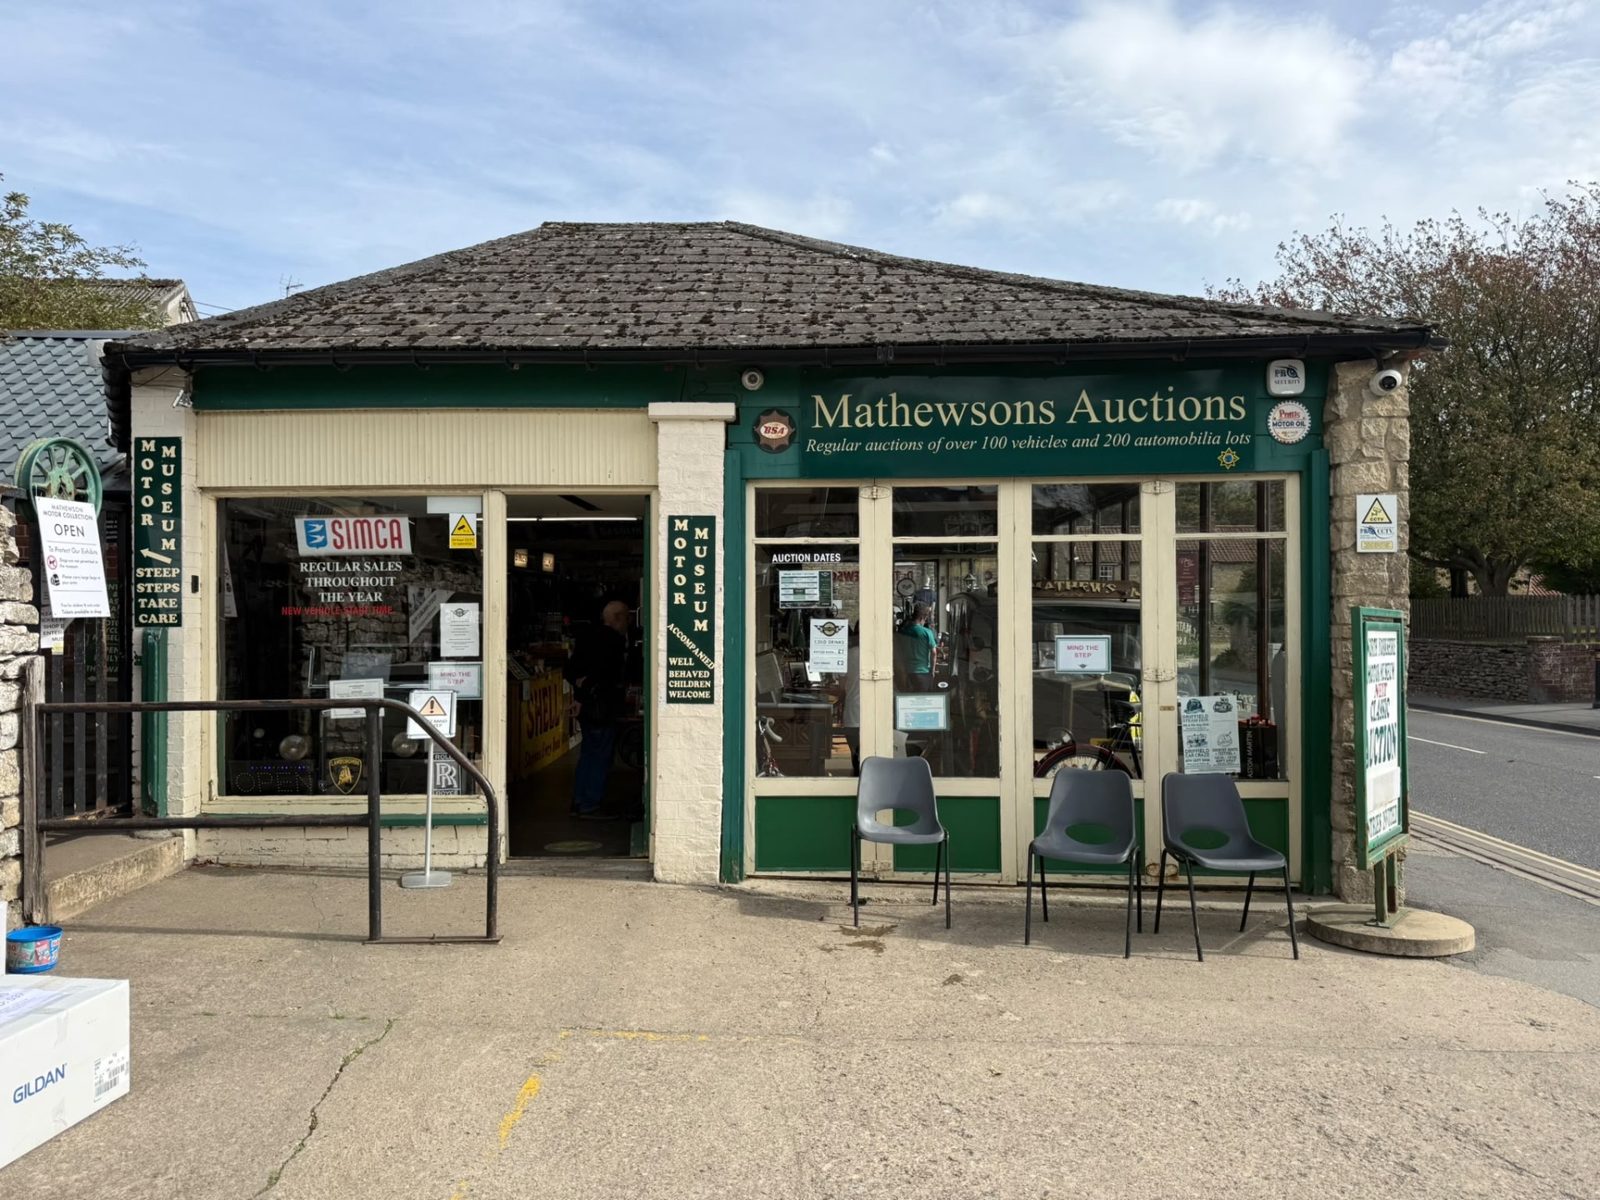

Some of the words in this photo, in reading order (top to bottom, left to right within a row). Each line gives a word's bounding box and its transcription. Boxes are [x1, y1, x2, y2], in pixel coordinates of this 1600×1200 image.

[811, 392, 1056, 428] Mathewsons
[1066, 386, 1246, 424] Auctions
[764, 425, 785, 434] BSA
[806, 438, 862, 456] Regular
[865, 438, 924, 452] auctions
[928, 436, 946, 454] of
[945, 440, 978, 450] over
[981, 436, 1008, 450] 100
[1012, 434, 1068, 450] vehicles
[1072, 434, 1100, 448] and
[1103, 433, 1130, 448] 200
[1134, 431, 1220, 447] automobilia
[1225, 430, 1250, 445] lots
[141, 440, 156, 526] MOTOR
[161, 446, 176, 551] MUSEUM
[51, 504, 83, 512] MATHEWSON
[54, 524, 85, 537] OPEN
[331, 519, 403, 550] SIMCA
[674, 519, 688, 604] MOTOR
[772, 553, 811, 562] AUCTION
[813, 553, 841, 562] DATES
[136, 567, 180, 578] STEEP
[300, 562, 360, 572] REGULAR
[364, 561, 403, 572] SALES
[306, 576, 396, 588] THROUGHOUT
[694, 528, 709, 632] MUSEUM
[136, 582, 180, 593] STEPS
[138, 598, 178, 608] TAKE
[318, 592, 345, 602] THE
[348, 592, 383, 602] YEAR
[282, 606, 302, 616] NEW
[304, 606, 342, 616] VEHICLE
[138, 613, 178, 624] CARE
[667, 623, 716, 670] ACCOMPANIED
[669, 657, 694, 666] WELL
[1374, 683, 1388, 698] NEXT
[527, 684, 560, 739] SHELL
[1370, 698, 1390, 721] CLASSIC
[234, 772, 312, 792] OPEN
[13, 1064, 65, 1104] GILDAN
